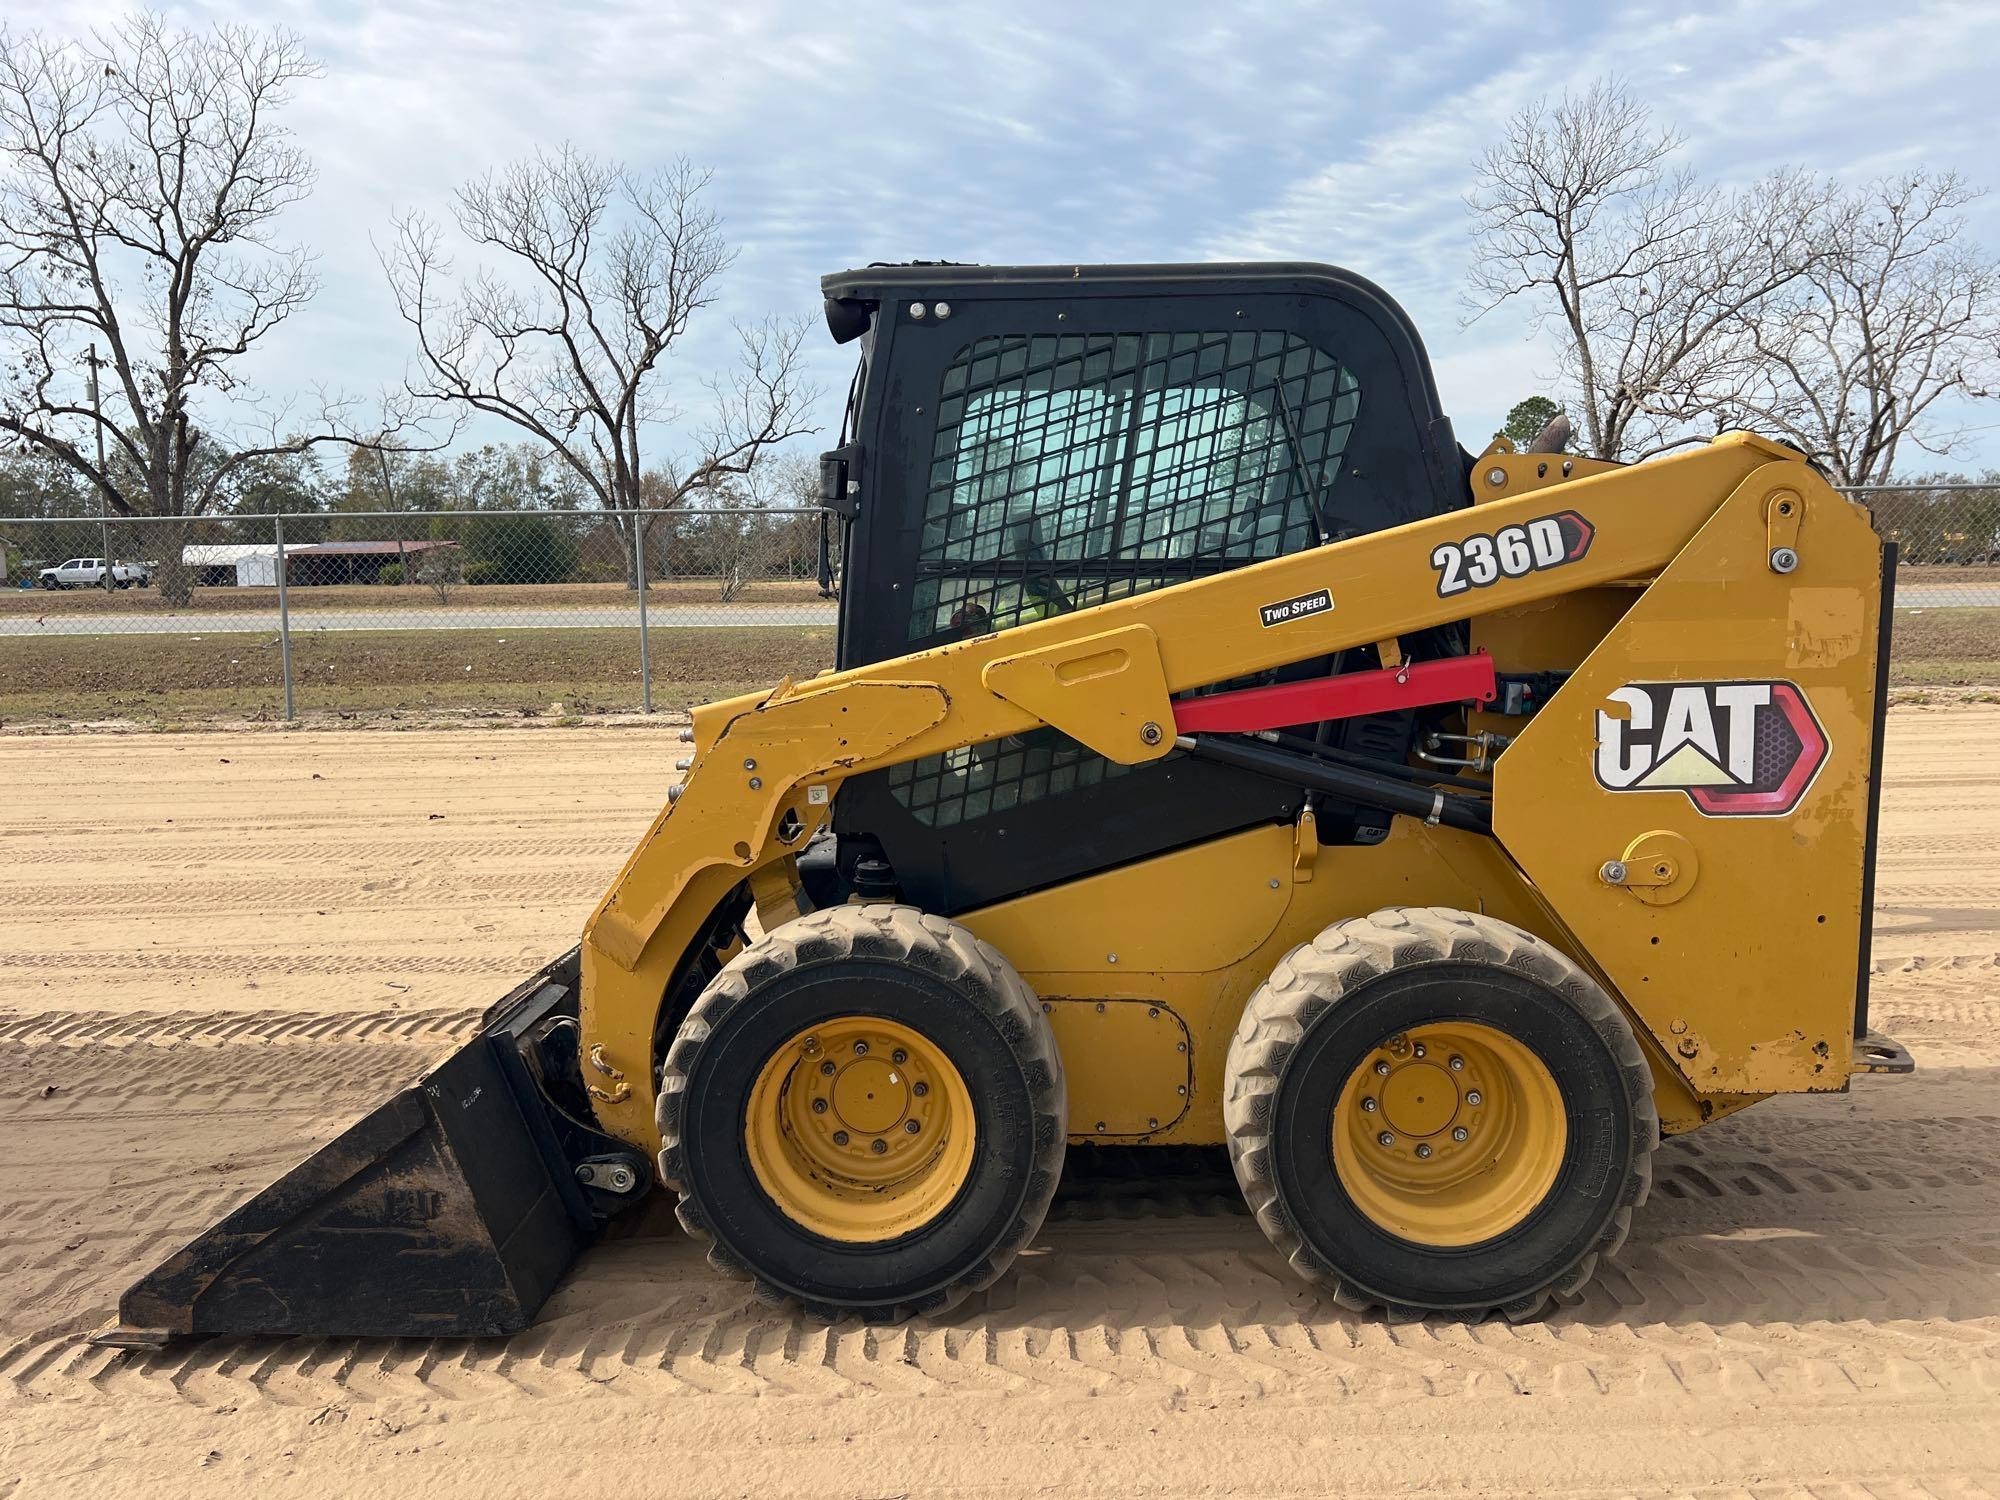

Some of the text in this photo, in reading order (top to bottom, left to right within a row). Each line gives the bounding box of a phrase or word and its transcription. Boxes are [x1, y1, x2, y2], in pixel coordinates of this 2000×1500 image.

[1433, 519, 1565, 594] 236D
[1264, 596, 1326, 622] TWO SPEED
[1599, 684, 1771, 788] CAT
